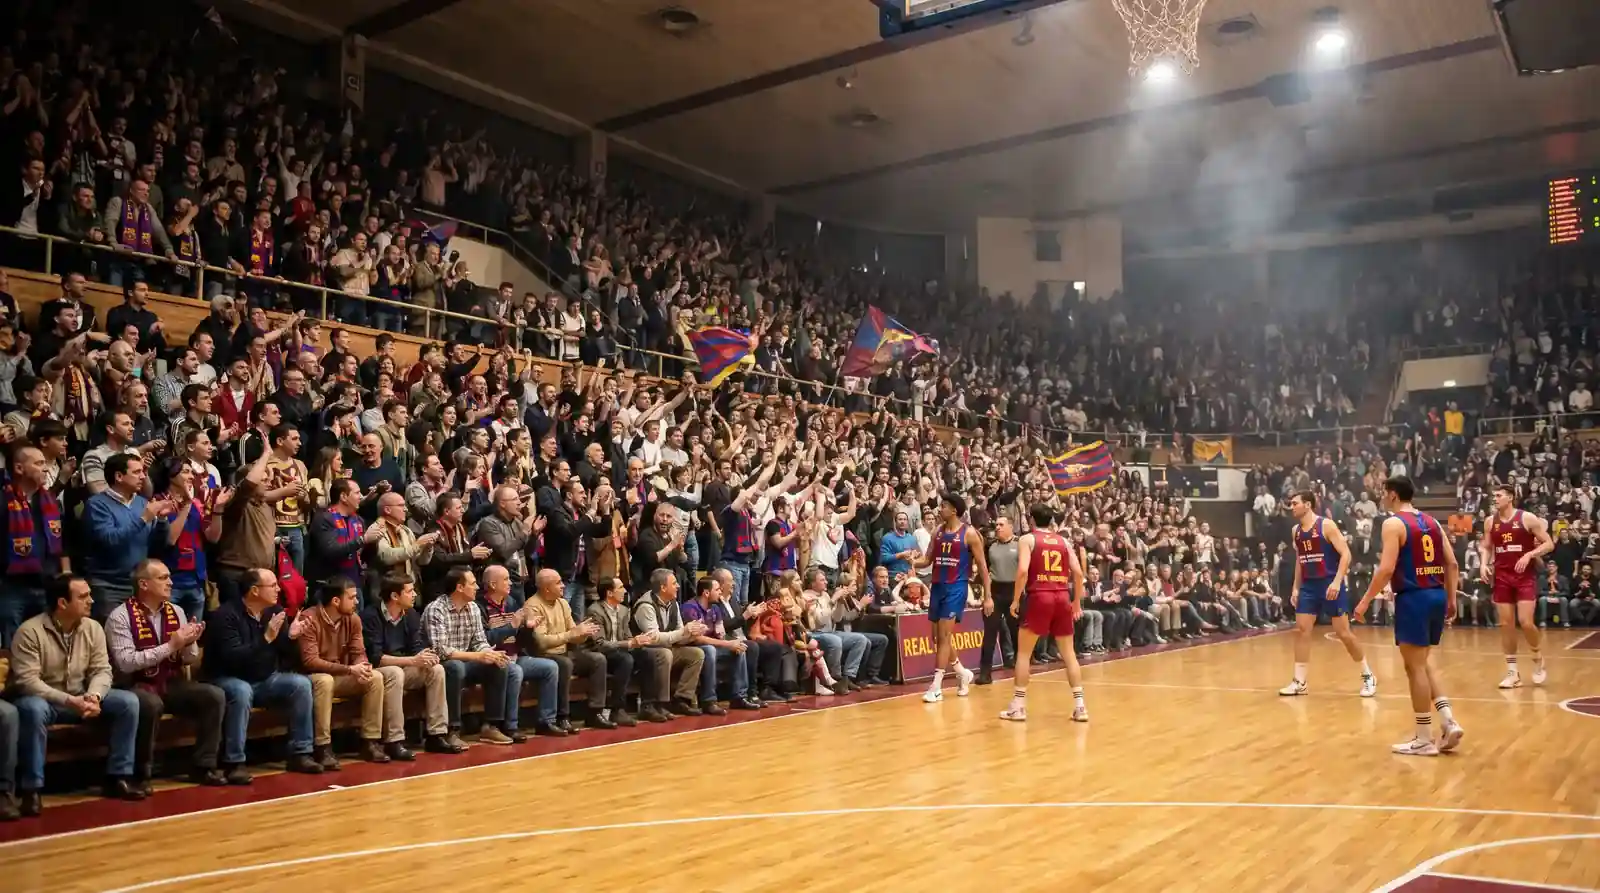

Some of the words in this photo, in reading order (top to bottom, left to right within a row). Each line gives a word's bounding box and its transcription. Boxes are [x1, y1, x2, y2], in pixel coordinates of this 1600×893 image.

[941, 542, 952, 554] 11
[1421, 534, 1435, 563] 9
[1041, 550, 1063, 572] 12
[903, 636, 934, 657] REAL
[934, 630, 982, 653] ADRID
